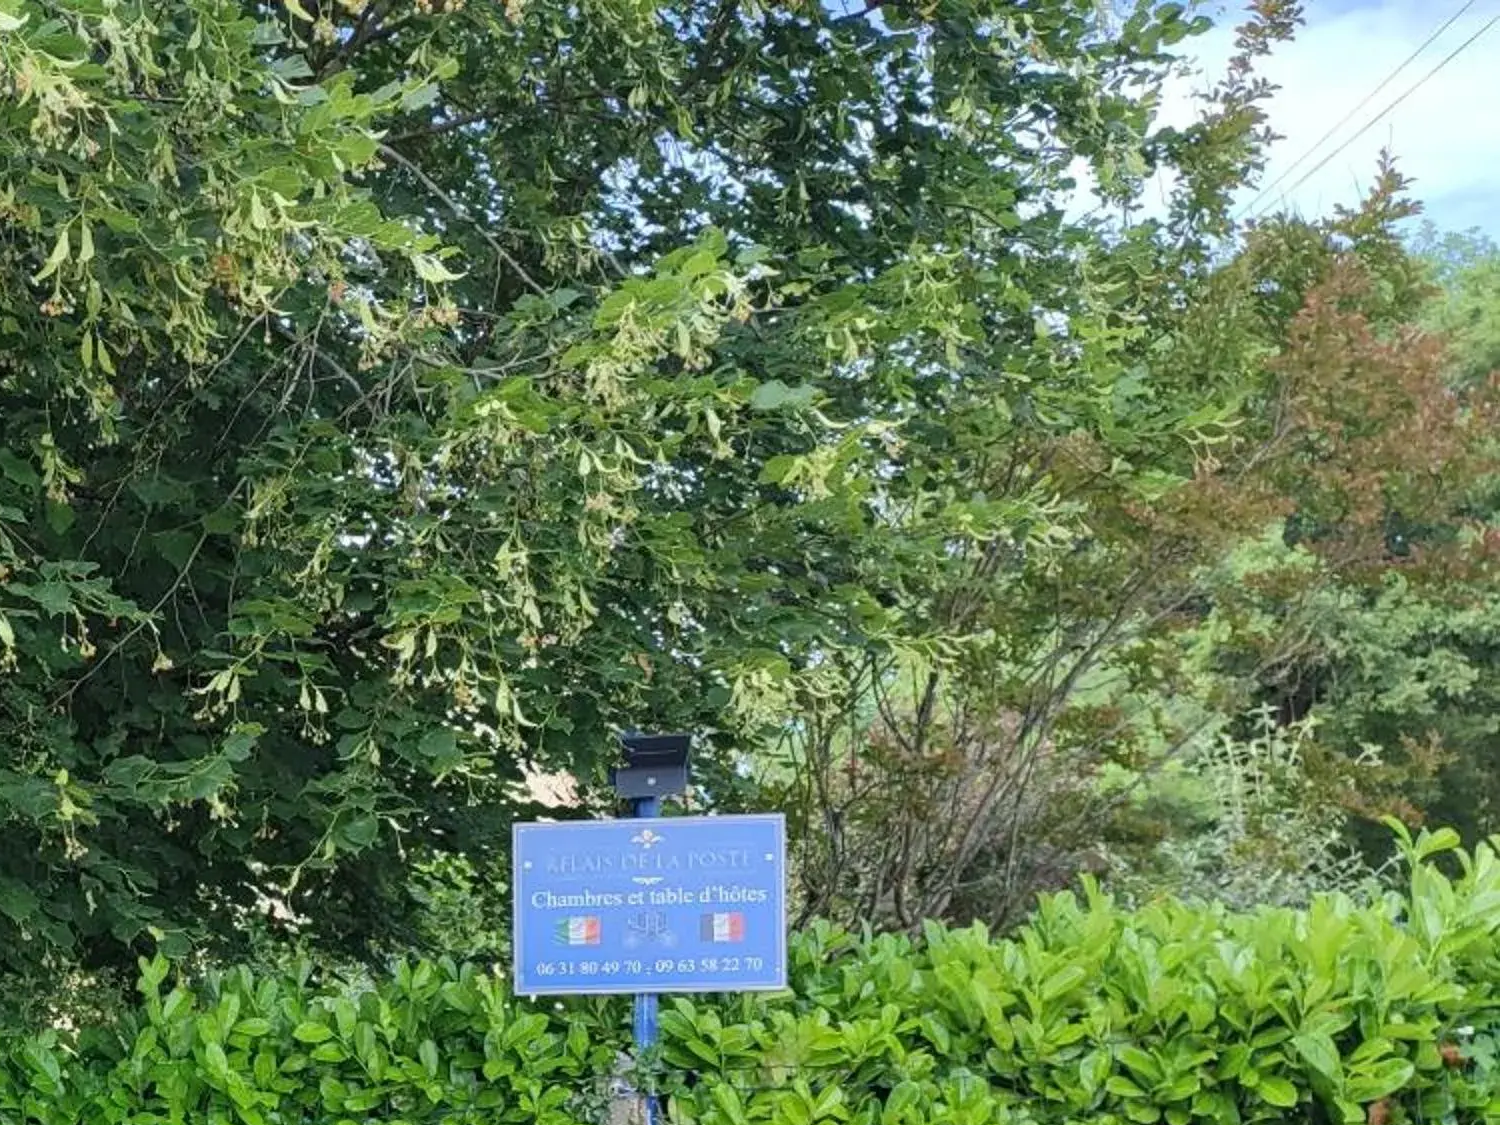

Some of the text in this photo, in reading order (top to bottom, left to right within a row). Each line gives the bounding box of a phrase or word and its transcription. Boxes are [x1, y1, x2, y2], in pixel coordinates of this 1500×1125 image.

[531, 885, 768, 909] Chambres et table d'hôtes
[536, 962, 553, 976] 06
[558, 961, 575, 975] 31
[580, 960, 598, 975] 80
[600, 960, 620, 974] 49
[624, 960, 642, 974] 70
[655, 958, 674, 973] 09
[677, 959, 695, 973] 63
[722, 957, 740, 971] 22
[744, 956, 763, 971] 70
